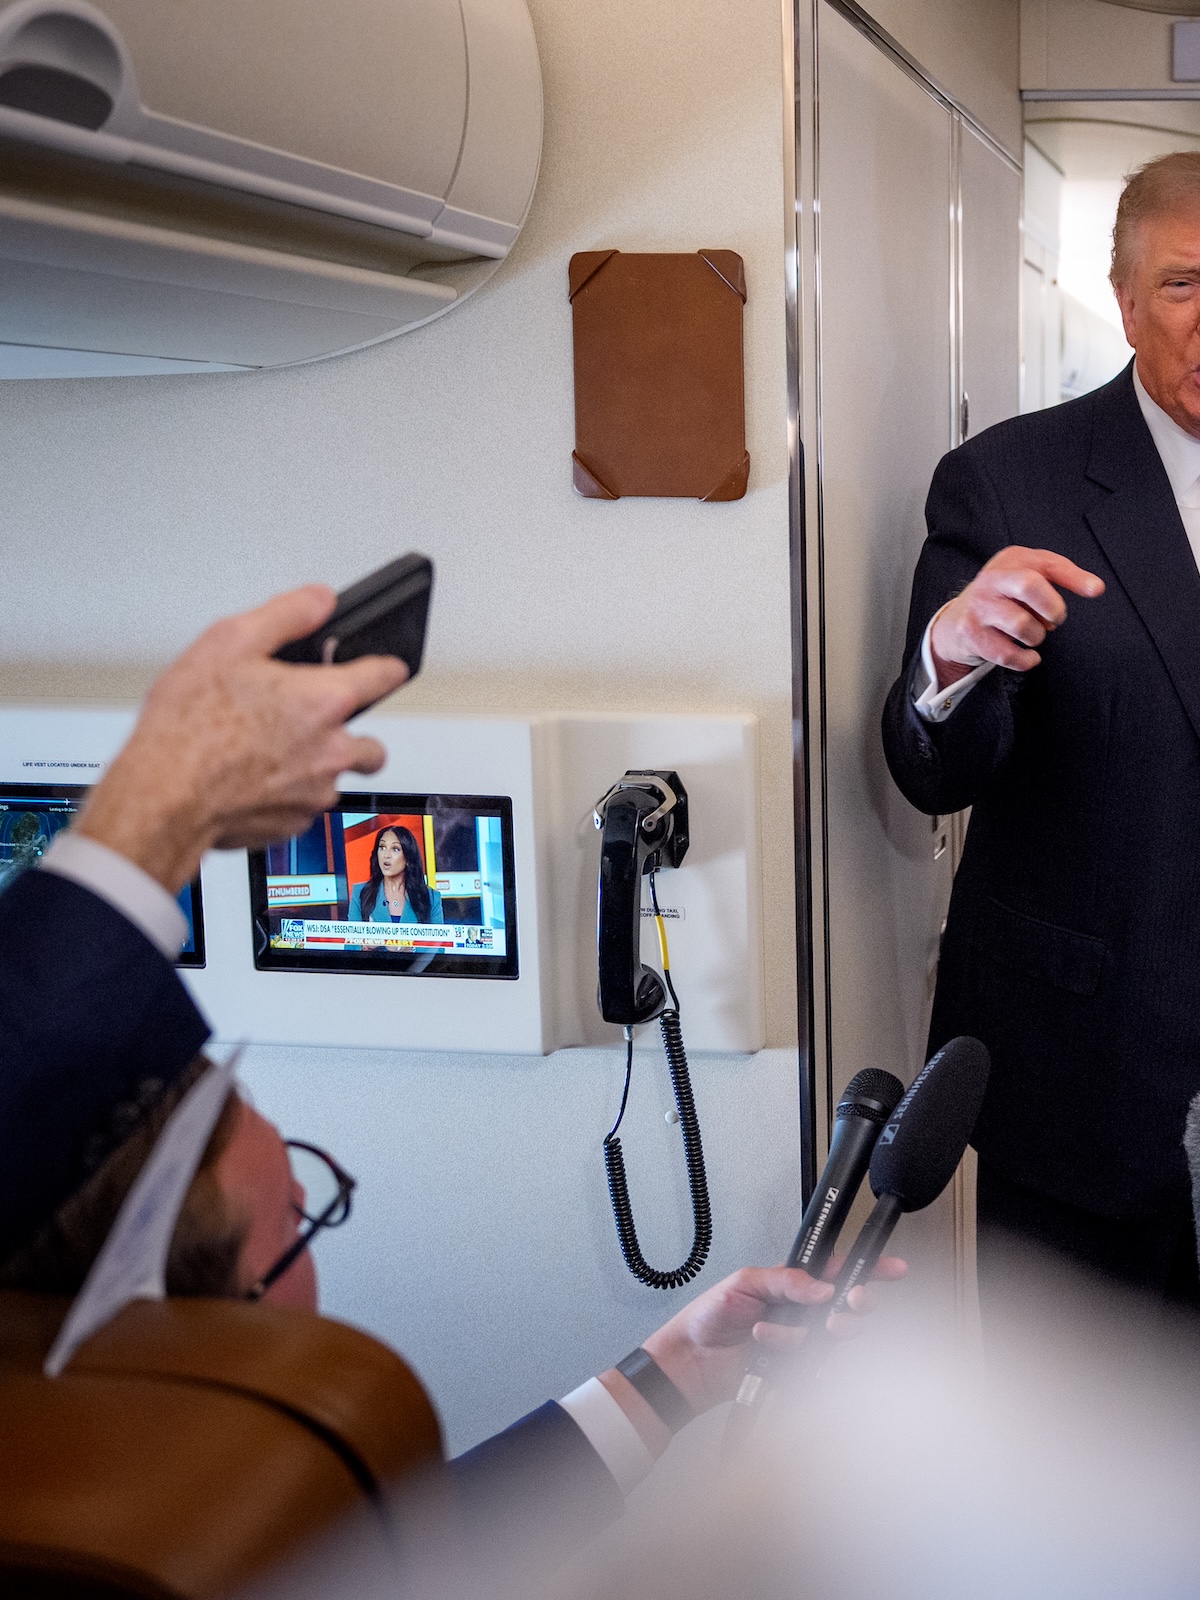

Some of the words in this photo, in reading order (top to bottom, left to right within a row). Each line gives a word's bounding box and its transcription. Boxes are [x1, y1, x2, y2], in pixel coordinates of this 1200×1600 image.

[268, 887, 309, 896] UTNUMBERED
[289, 924, 303, 932] FOX
[307, 924, 319, 933] WSJ:
[320, 925, 330, 933] DSA
[332, 925, 365, 934] "ESSENTIALLY
[366, 926, 391, 935] BLOWING
[392, 927, 399, 935] UP
[400, 927, 409, 936] THE
[410, 928, 450, 937] CONSTITUTION"
[385, 939, 414, 947] ALERT
[894, 1051, 946, 1120] SENNHEISER
[801, 1201, 832, 1264] SENNHEISER
